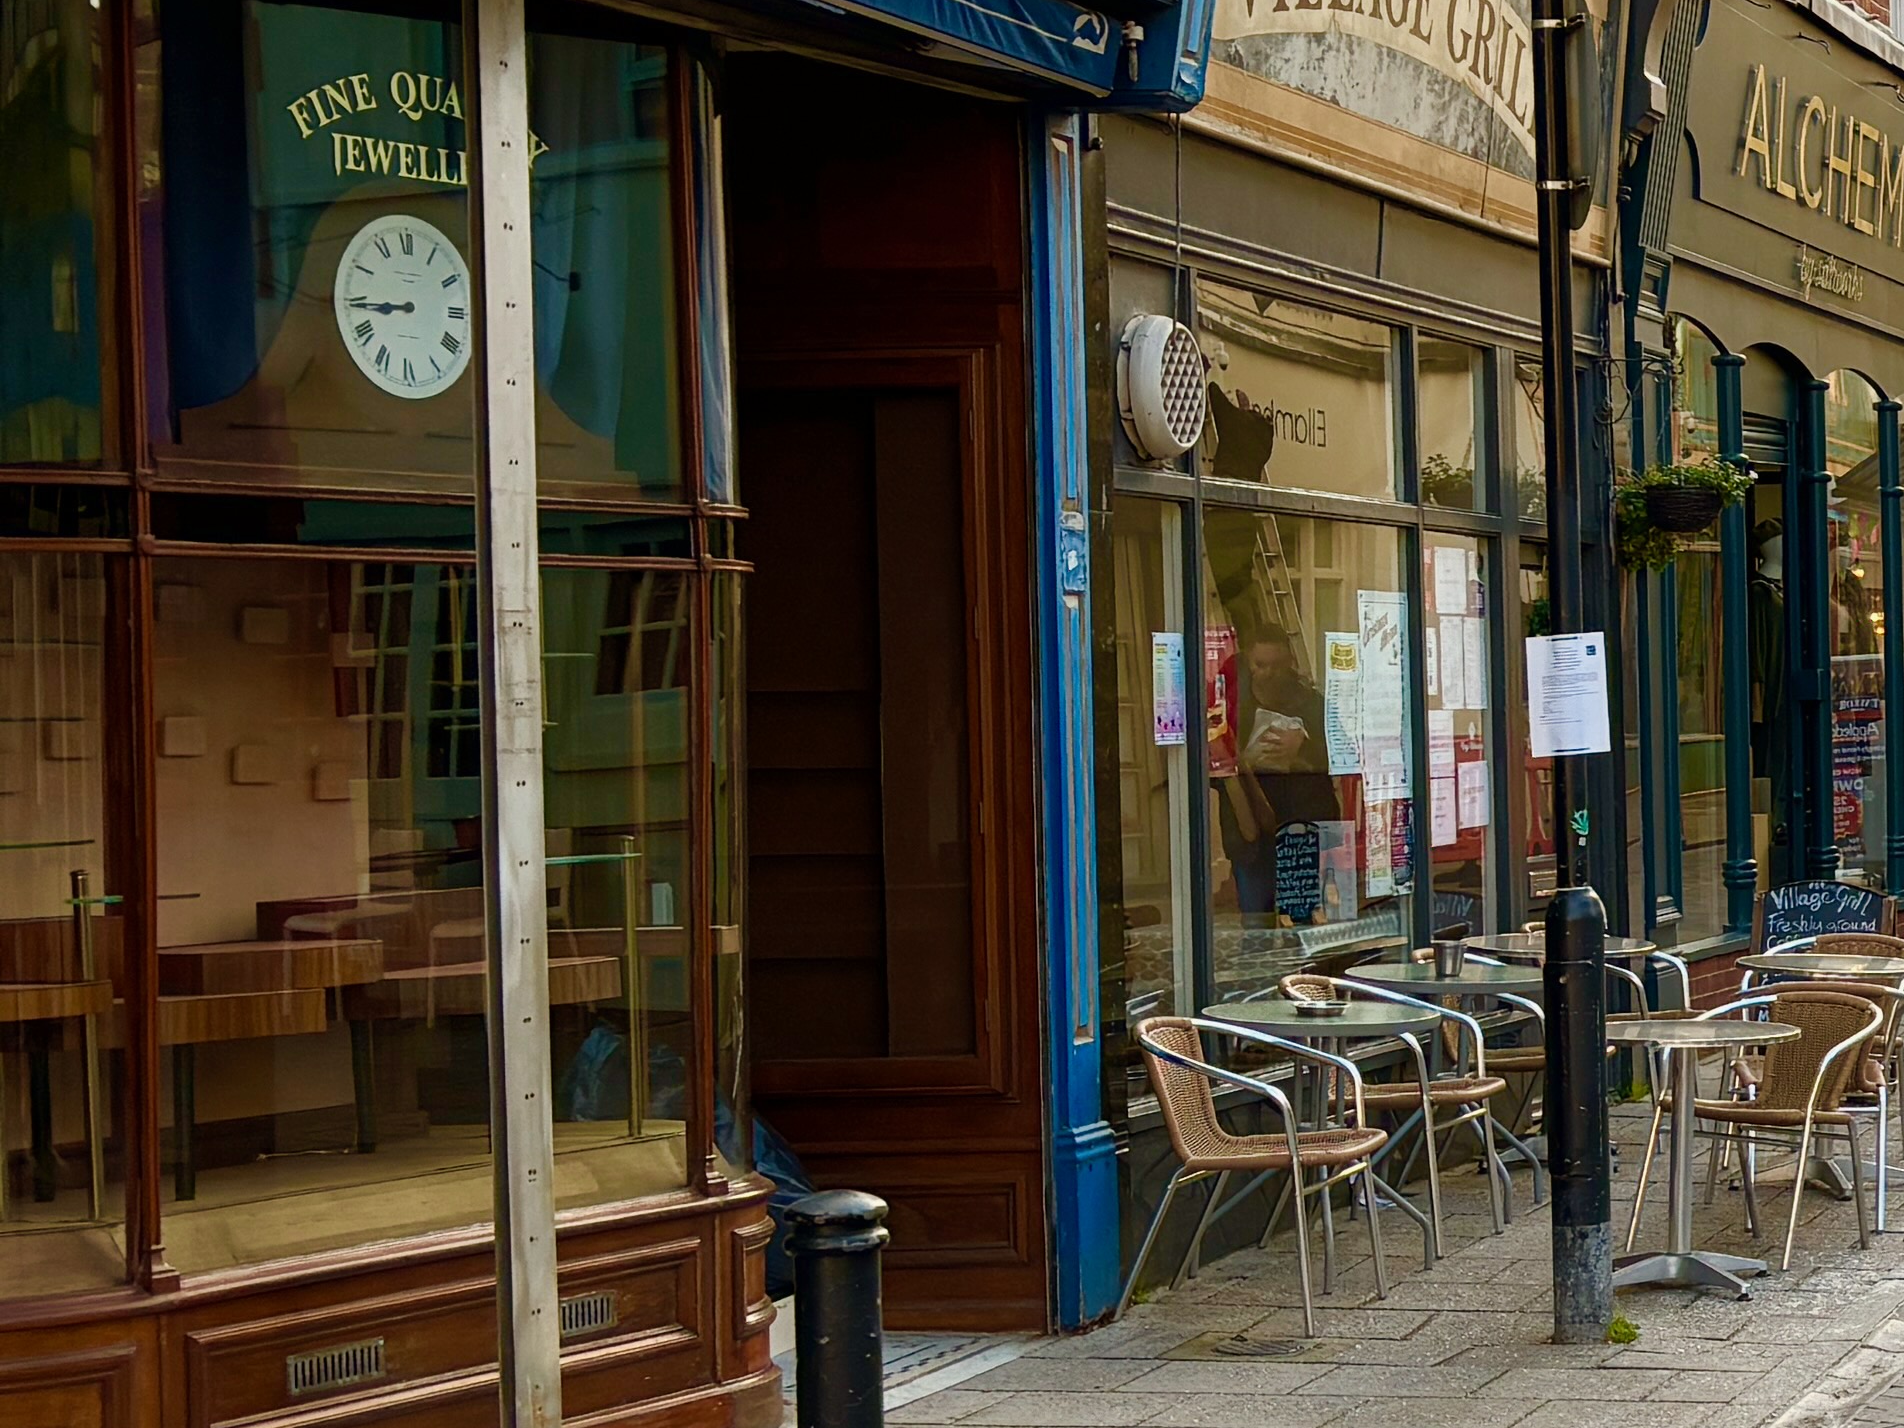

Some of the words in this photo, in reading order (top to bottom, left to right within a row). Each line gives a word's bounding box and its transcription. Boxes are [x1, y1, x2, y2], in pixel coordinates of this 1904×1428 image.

[287, 73, 377, 139] FINE
[331, 130, 550, 186] JEWELLY
[1767, 911, 1822, 933] Freshly
[1825, 918, 1877, 933] ground
[1770, 885, 1836, 912] Village
[1835, 885, 1873, 916] Grill
